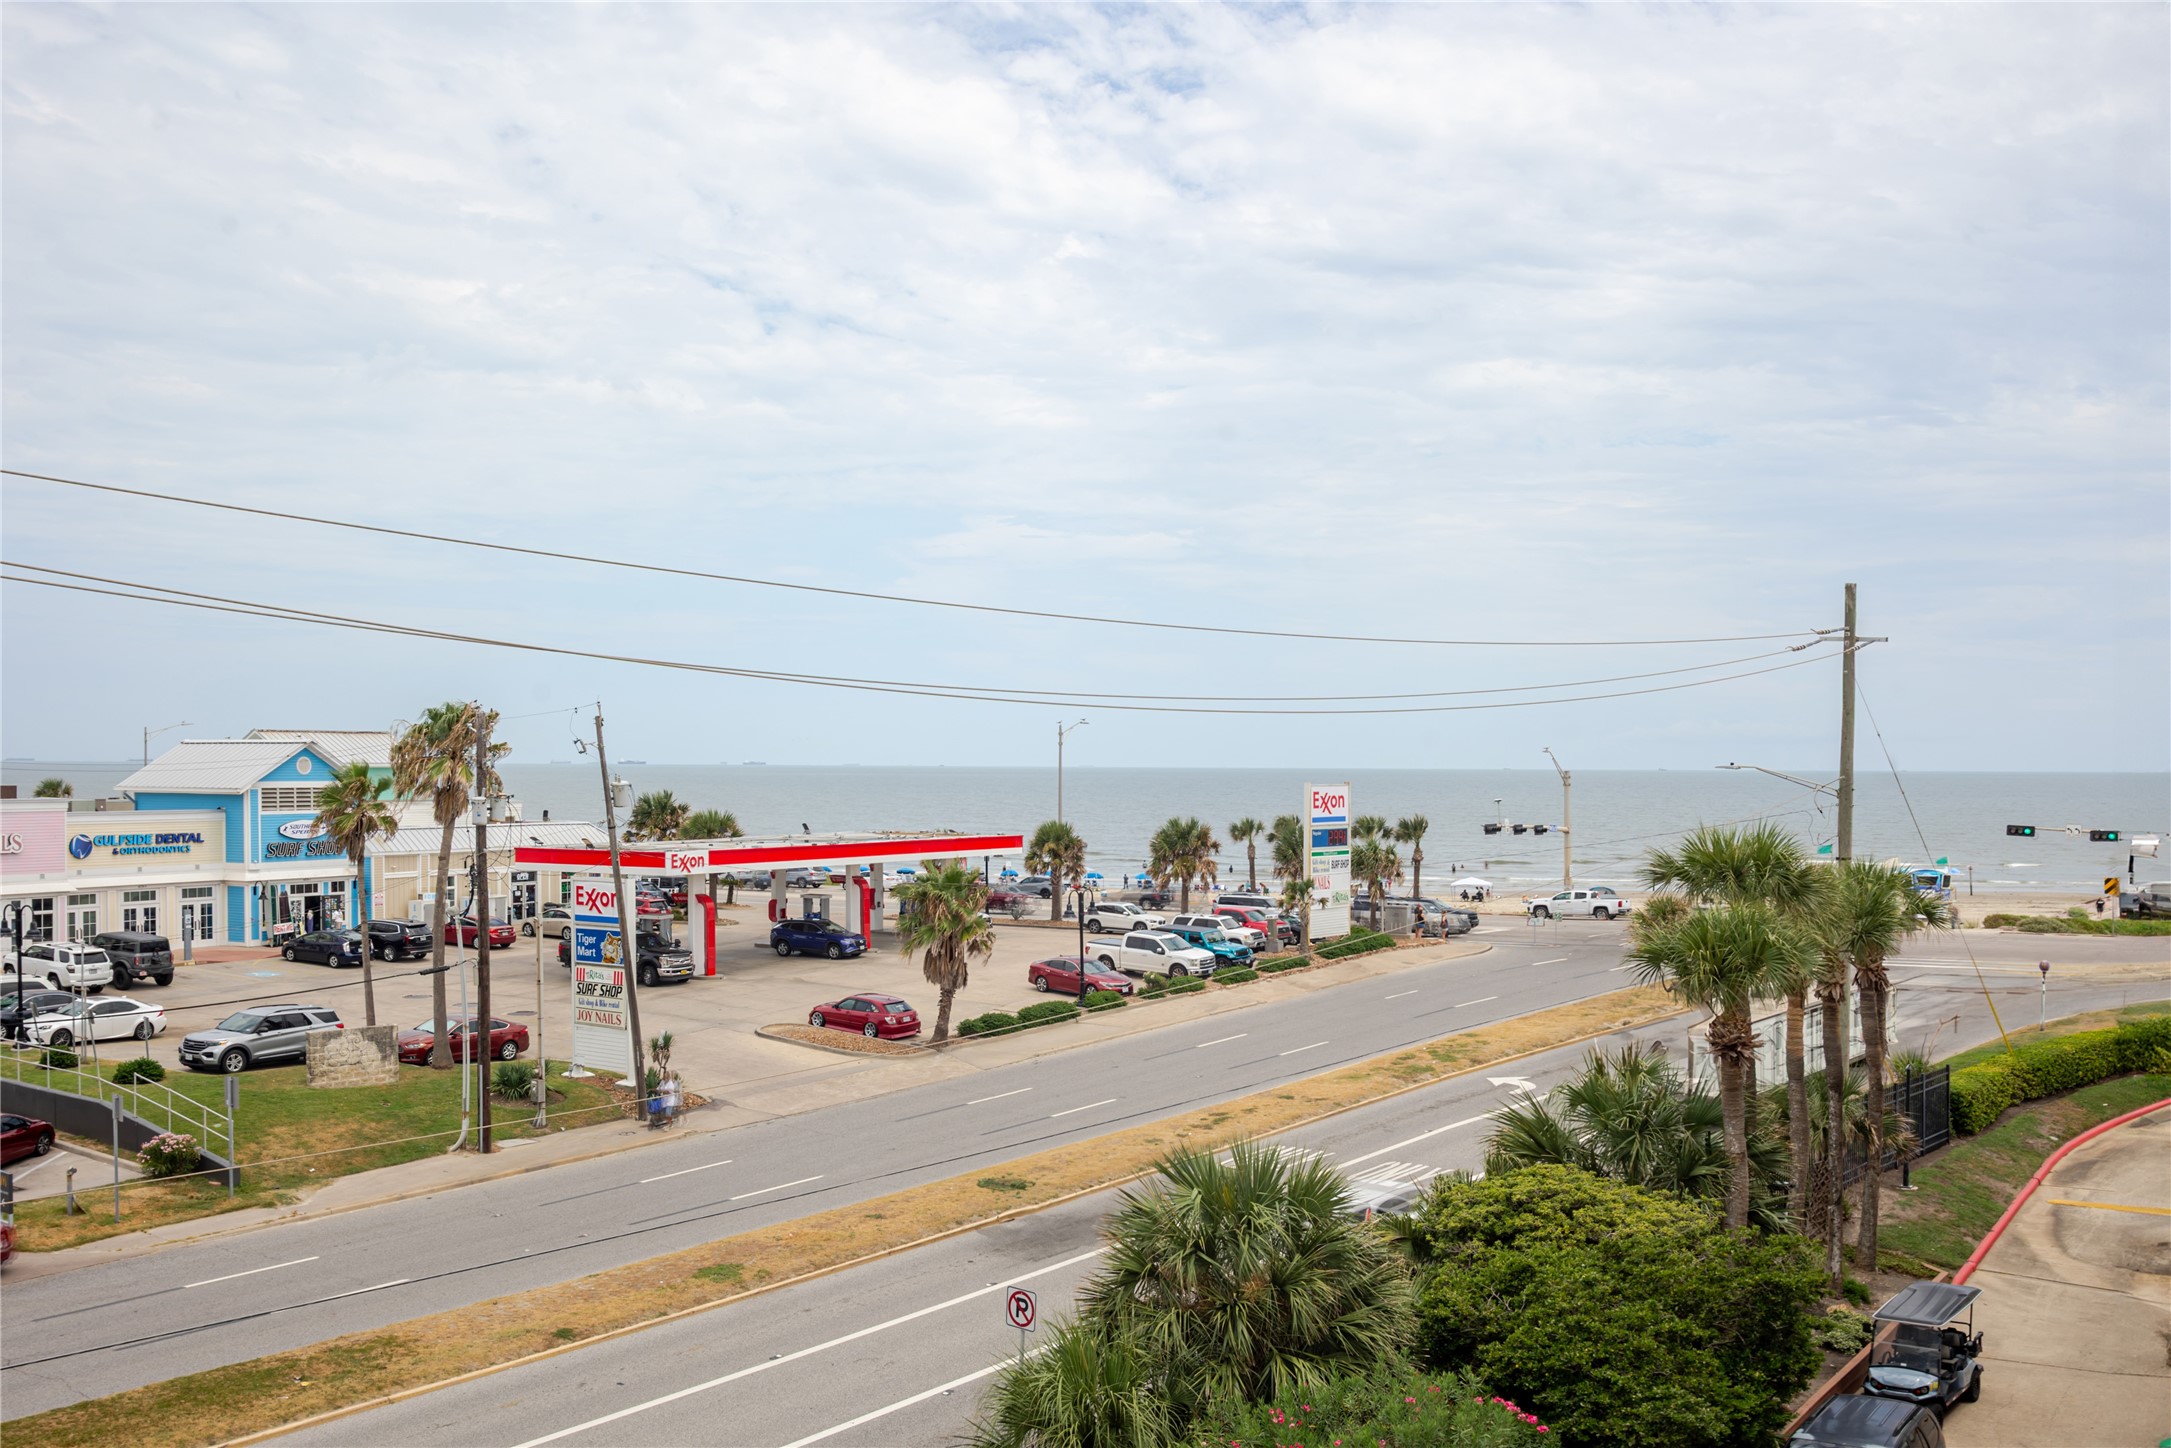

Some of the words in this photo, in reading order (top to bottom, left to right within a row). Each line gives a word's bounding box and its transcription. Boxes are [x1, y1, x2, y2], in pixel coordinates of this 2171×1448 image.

[1313, 791, 1345, 814] Exxon
[93, 834, 153, 847] GULFSIDE
[155, 833, 204, 845] DENTAL
[112, 848, 119, 856] &
[120, 845, 191, 855] ORTHODONTICS
[265, 841, 304, 858] SURF
[305, 840, 341, 857] SHO
[671, 854, 704, 873] Exxon
[577, 933, 597, 946] Tiger
[577, 946, 597, 957] Mart
[576, 982, 598, 995] SURF
[599, 985, 622, 998] SHOP
[577, 1010, 593, 1021] JOY
[596, 1012, 622, 1026] NAILS
